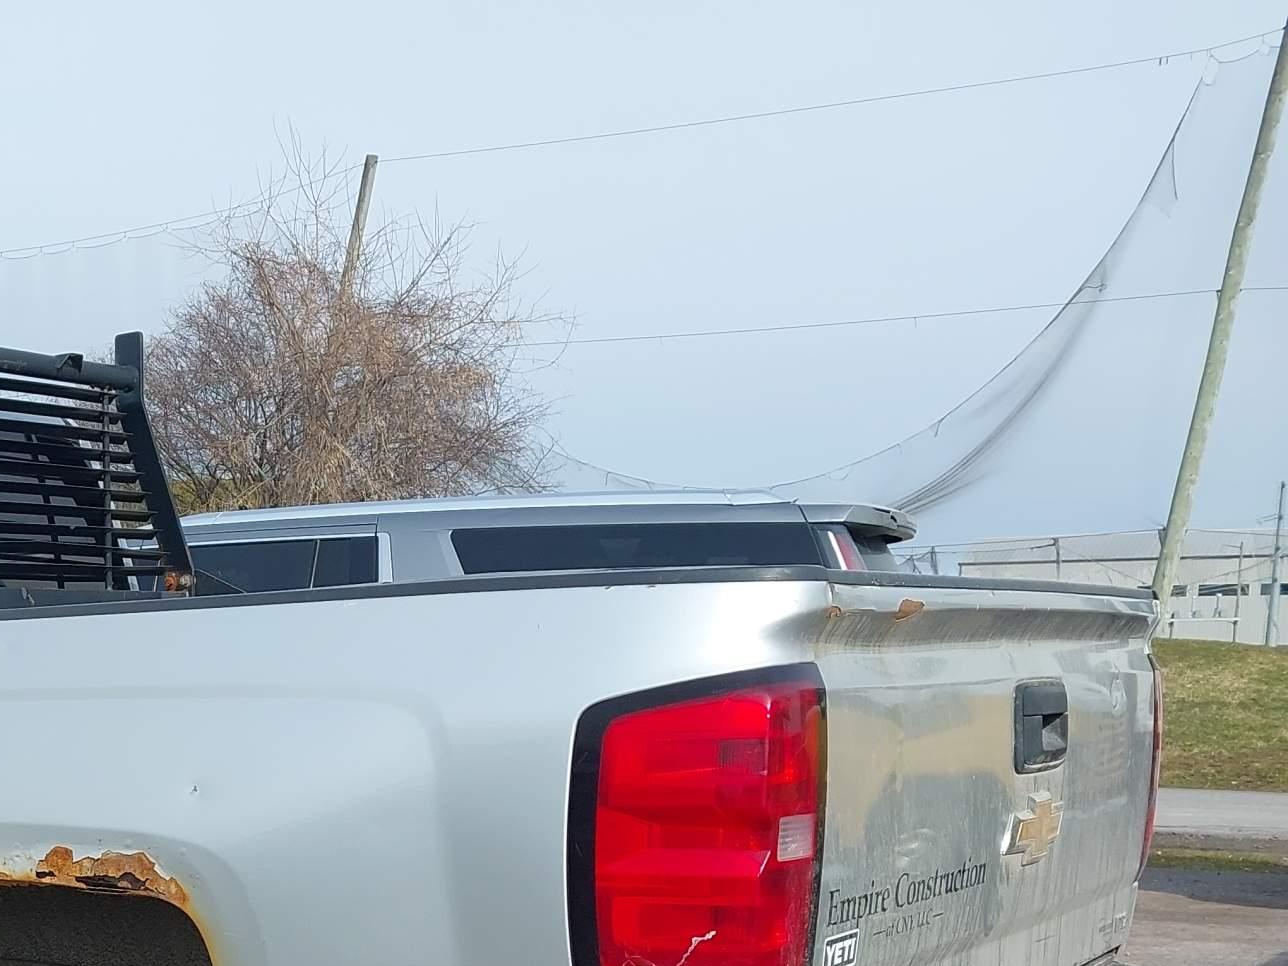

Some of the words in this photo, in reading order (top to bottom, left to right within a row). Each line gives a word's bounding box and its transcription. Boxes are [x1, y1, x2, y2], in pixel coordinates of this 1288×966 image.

[827, 880, 890, 928] Empire
[895, 856, 987, 908] Construction
[826, 937, 857, 966] YETI
